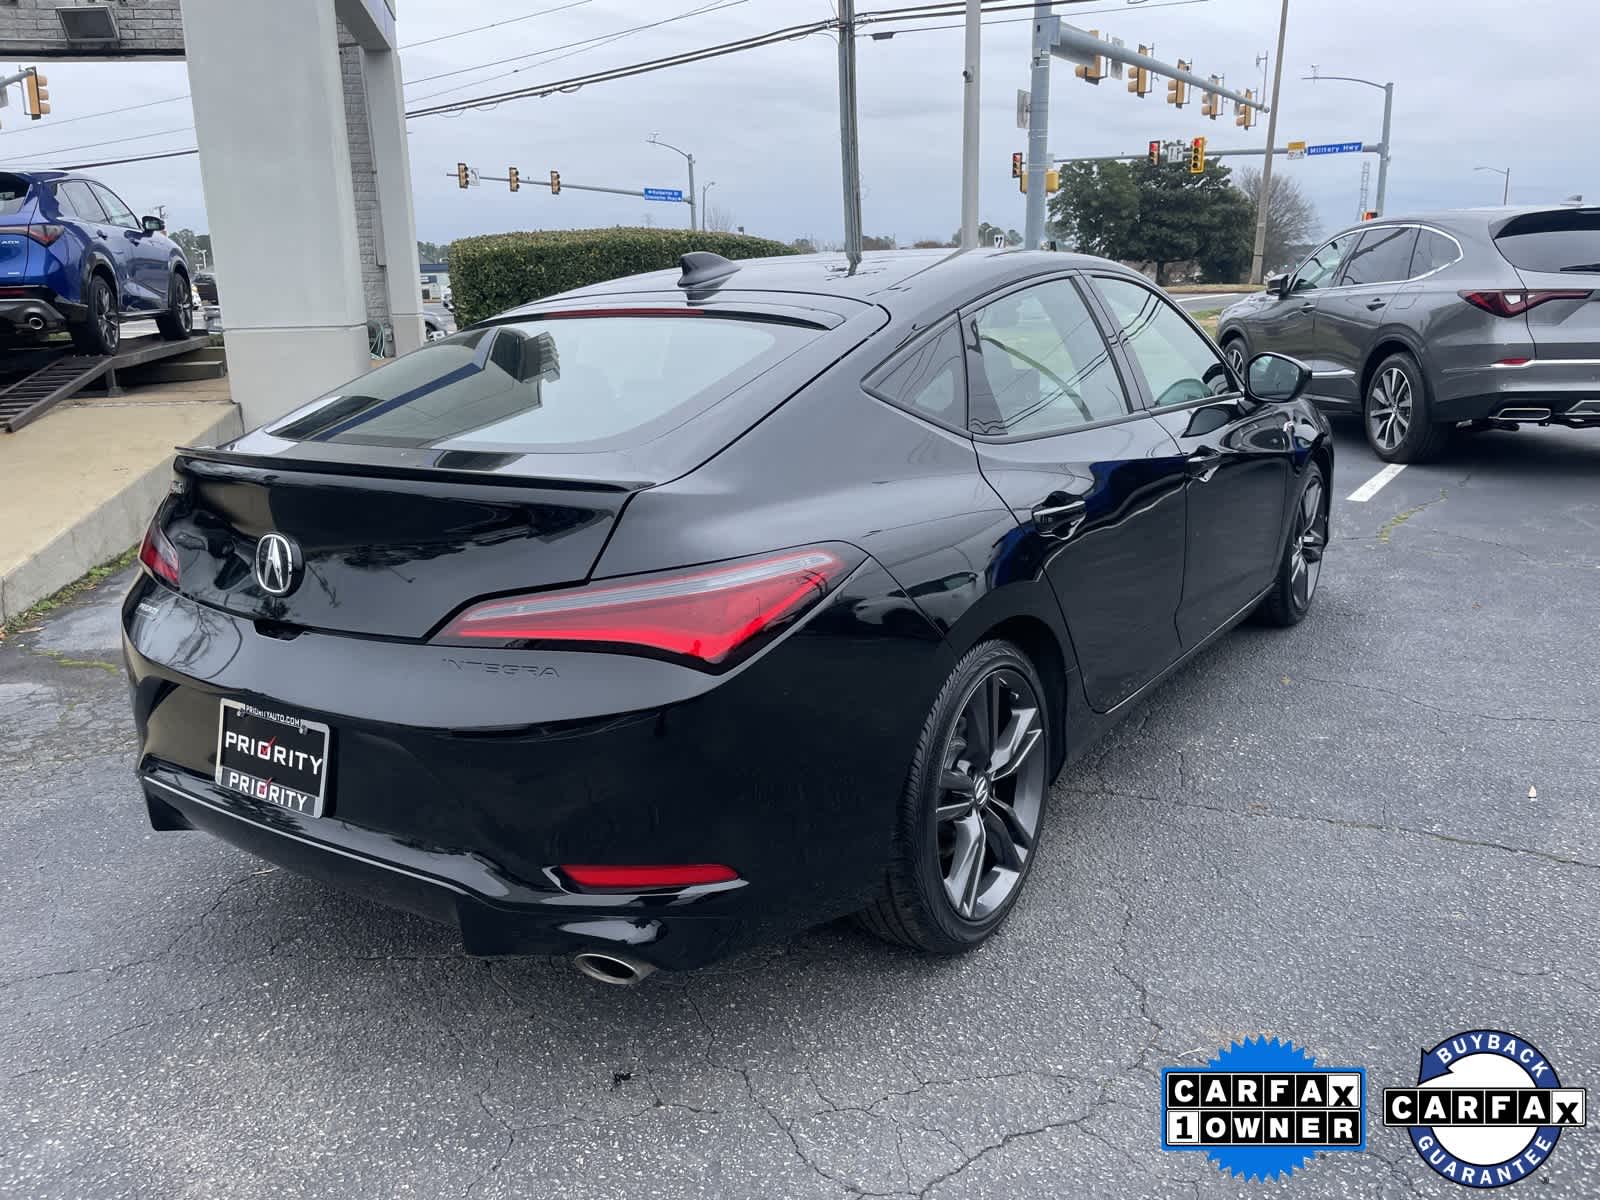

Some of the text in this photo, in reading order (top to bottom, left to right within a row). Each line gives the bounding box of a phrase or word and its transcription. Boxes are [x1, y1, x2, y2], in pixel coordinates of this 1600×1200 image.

[1309, 144, 1359, 154] Military Hwy
[441, 658, 560, 679] INTEGRA
[225, 731, 323, 775] PRIORITY
[229, 771, 307, 811] PRIORITY
